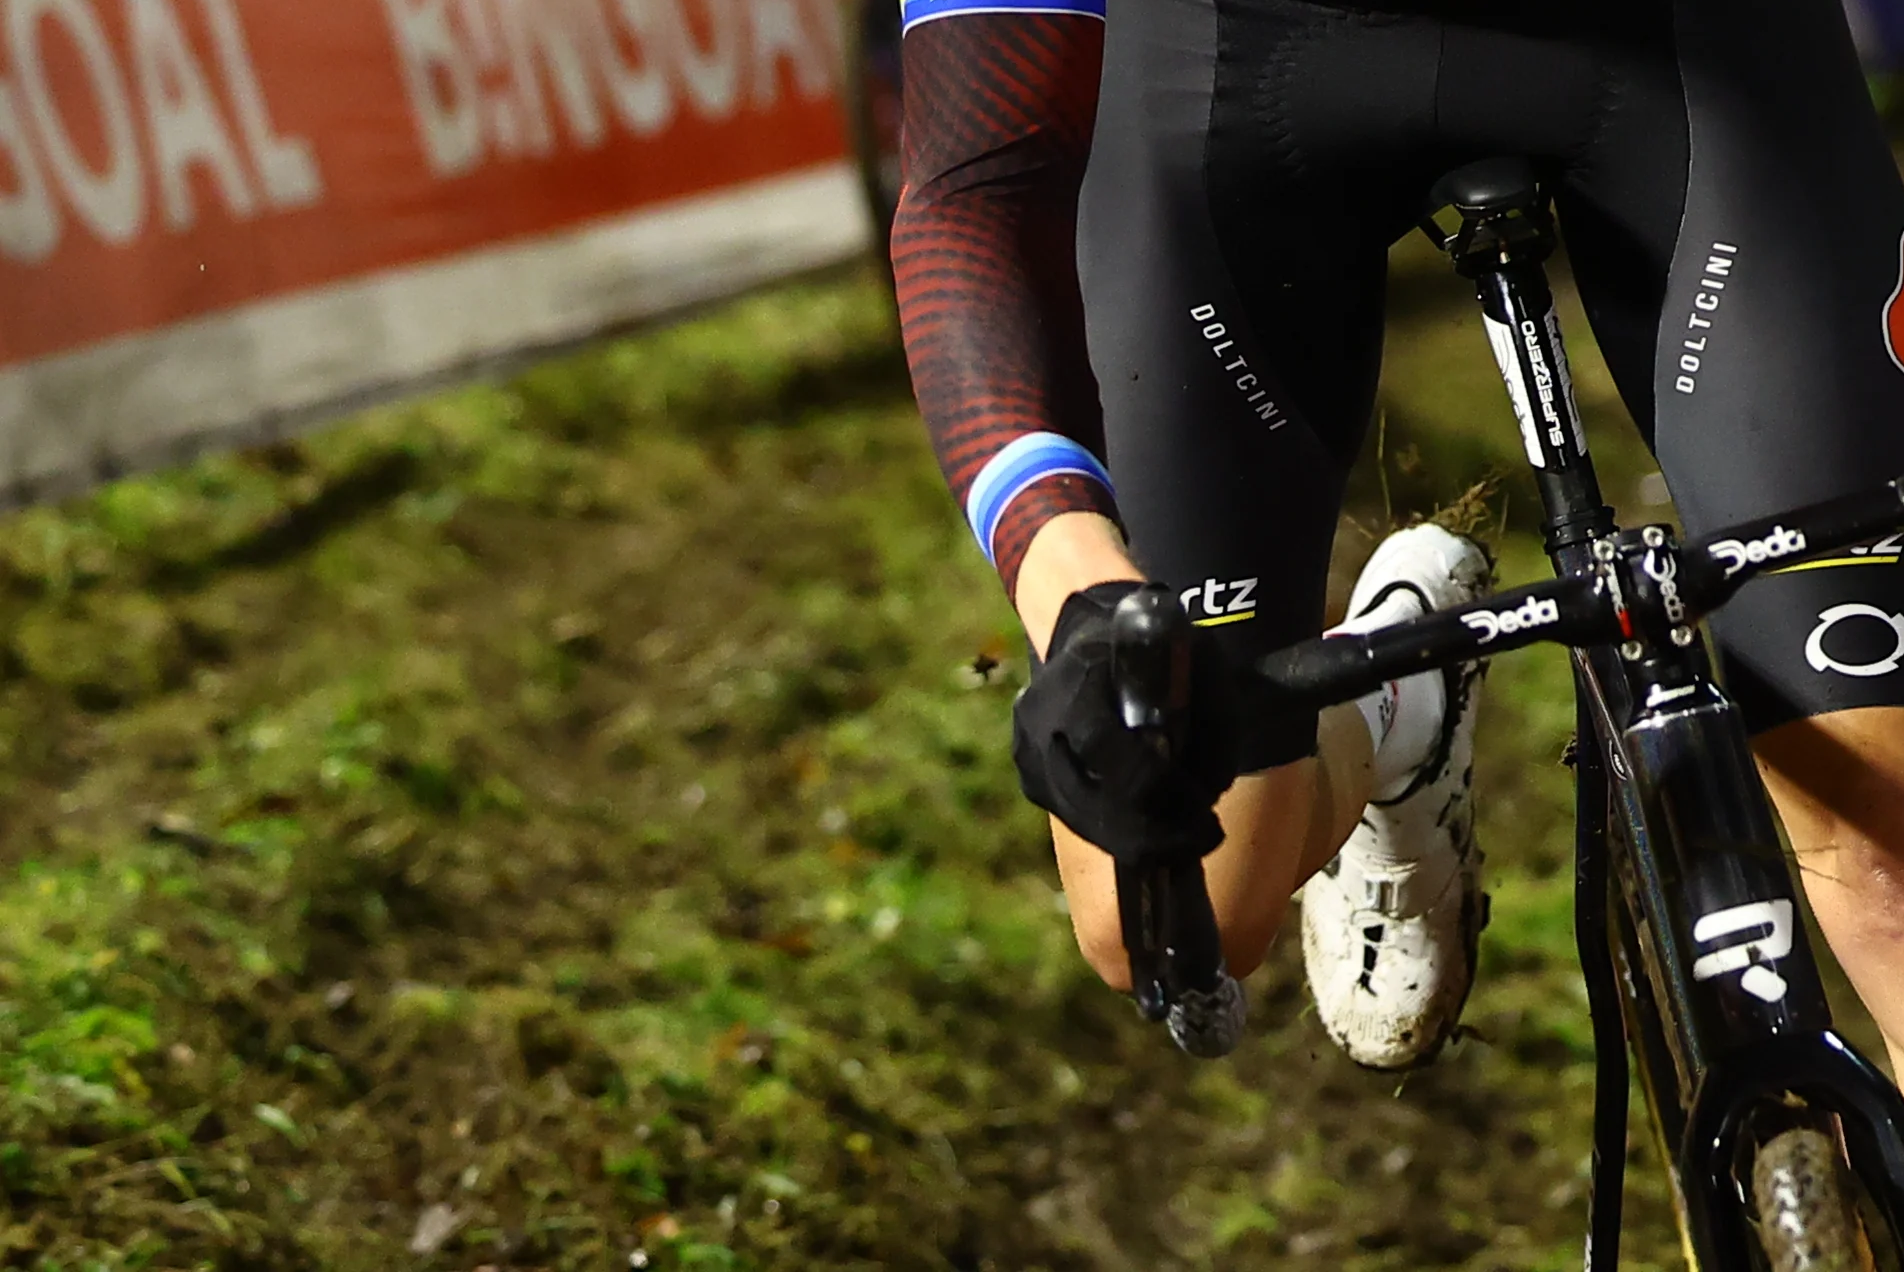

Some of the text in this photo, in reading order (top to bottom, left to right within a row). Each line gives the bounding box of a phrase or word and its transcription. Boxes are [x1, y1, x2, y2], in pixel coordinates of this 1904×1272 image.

[1676, 241, 1738, 396] DOLTCINI
[1190, 303, 1288, 431] DOLTCINI
[1521, 320, 1566, 447] SUPERZERO
[1179, 576, 1258, 615] rtz
[1708, 526, 1807, 580] Deda
[1460, 595, 1559, 645] Deda
